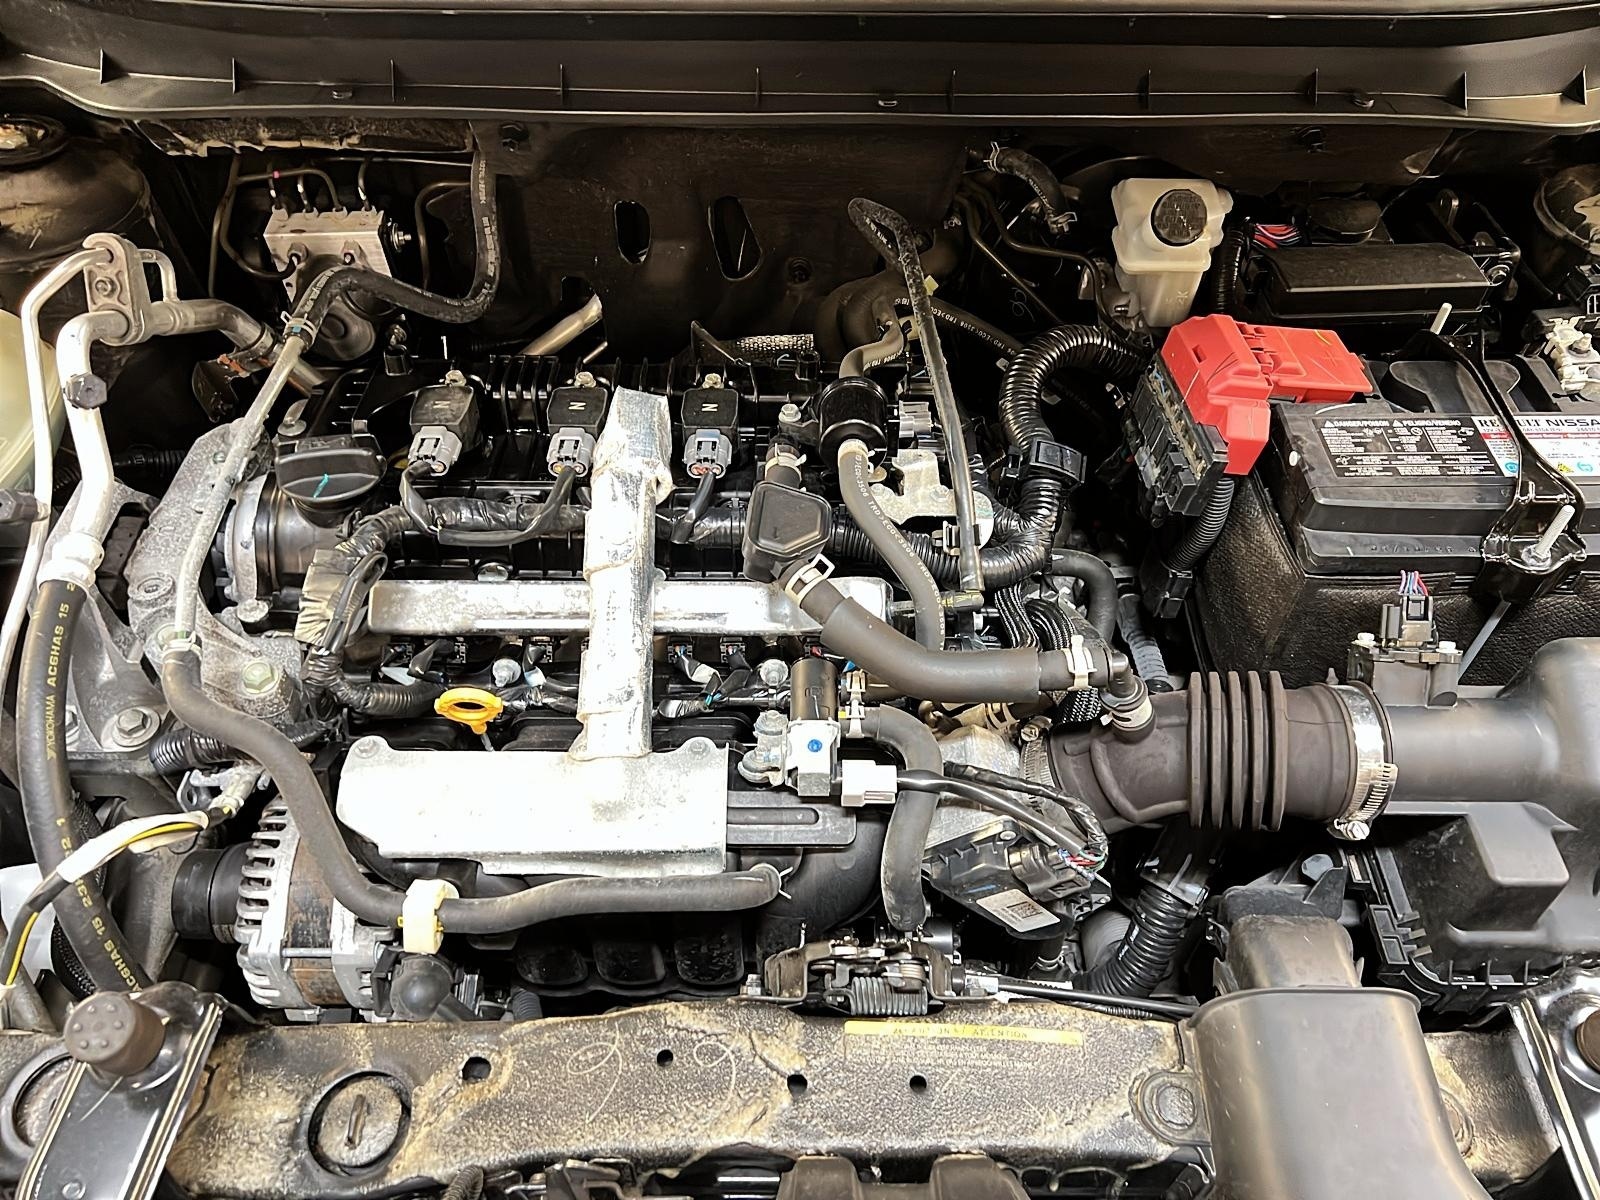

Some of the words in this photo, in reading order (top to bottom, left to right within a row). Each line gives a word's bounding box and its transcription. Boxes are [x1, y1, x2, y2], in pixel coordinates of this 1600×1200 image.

[1478, 419, 1541, 427] REULT
[1545, 419, 1600, 427] NISSA
[46, 627, 65, 689] AC6HAS
[58, 603, 70, 621] 15
